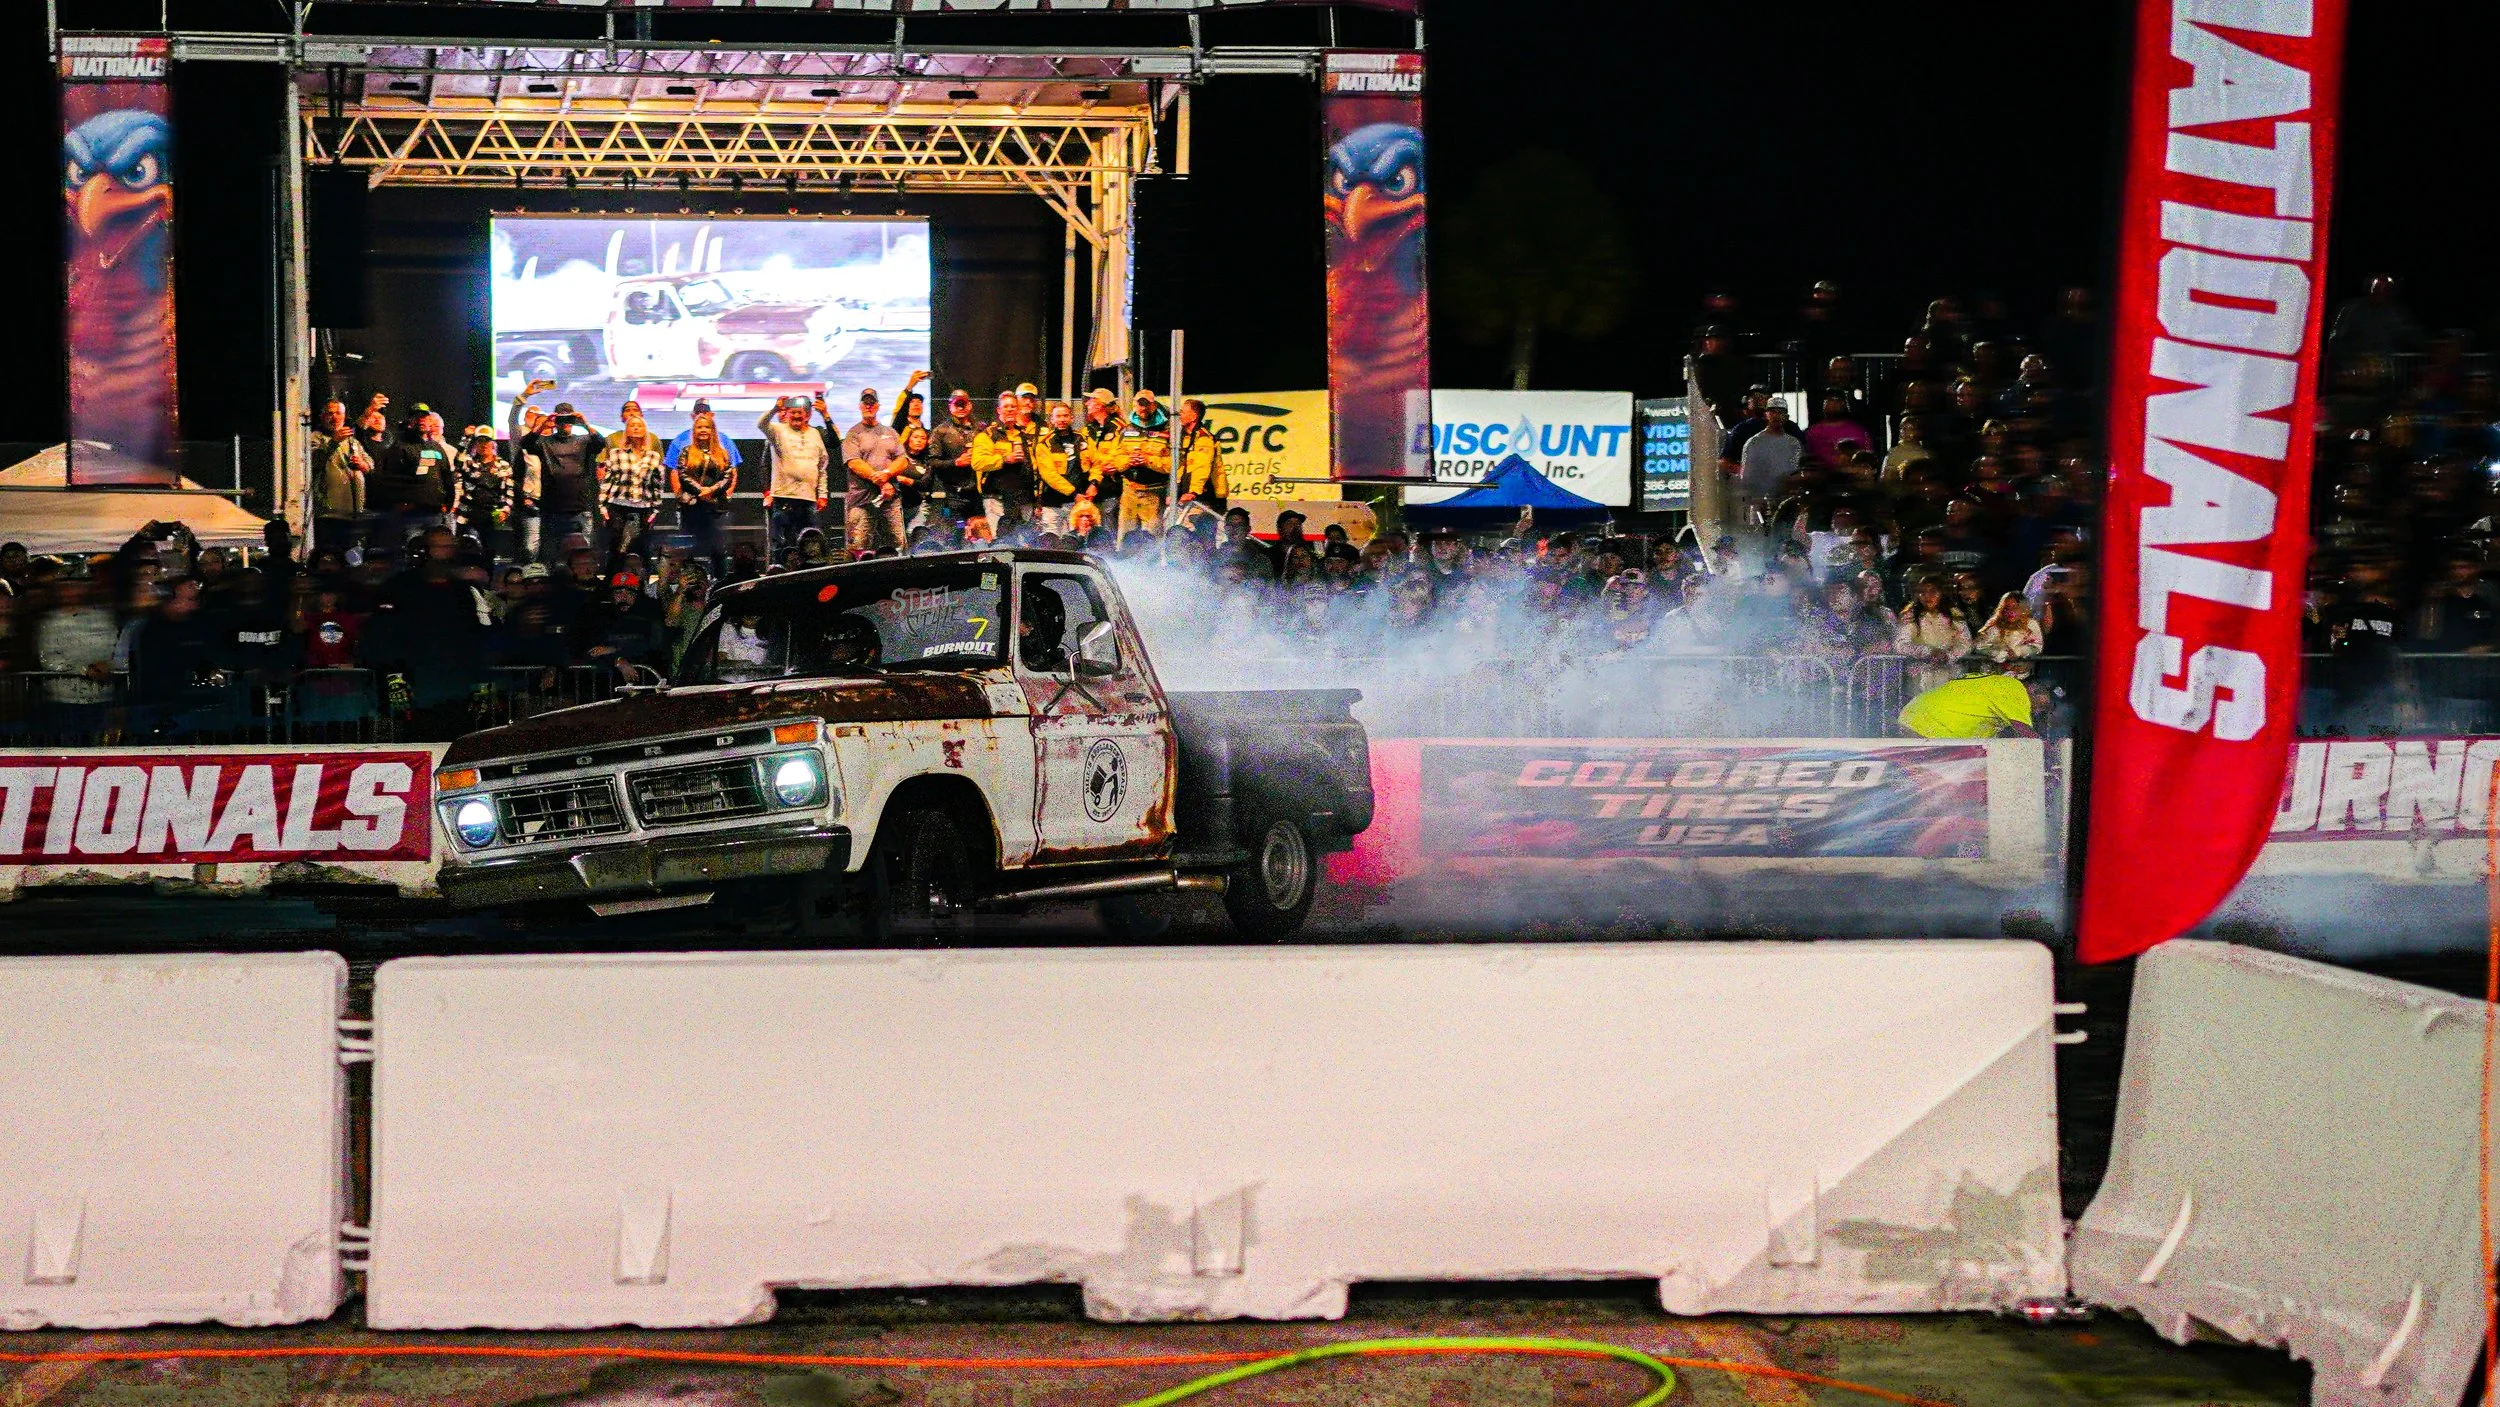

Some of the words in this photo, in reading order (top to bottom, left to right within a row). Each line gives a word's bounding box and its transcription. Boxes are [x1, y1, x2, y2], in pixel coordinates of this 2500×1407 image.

[72, 57, 166, 76] NATIONALS
[1337, 72, 1421, 91] NATIONALS
[1204, 420, 1288, 455] erc
[1546, 461, 1585, 479] Inc.
[967, 616, 989, 640] 7
[922, 641, 996, 658] BURNOUT
[1515, 760, 1889, 788] COLORED
[1593, 793, 1839, 819] TIRES
[1637, 824, 1771, 847] USA
